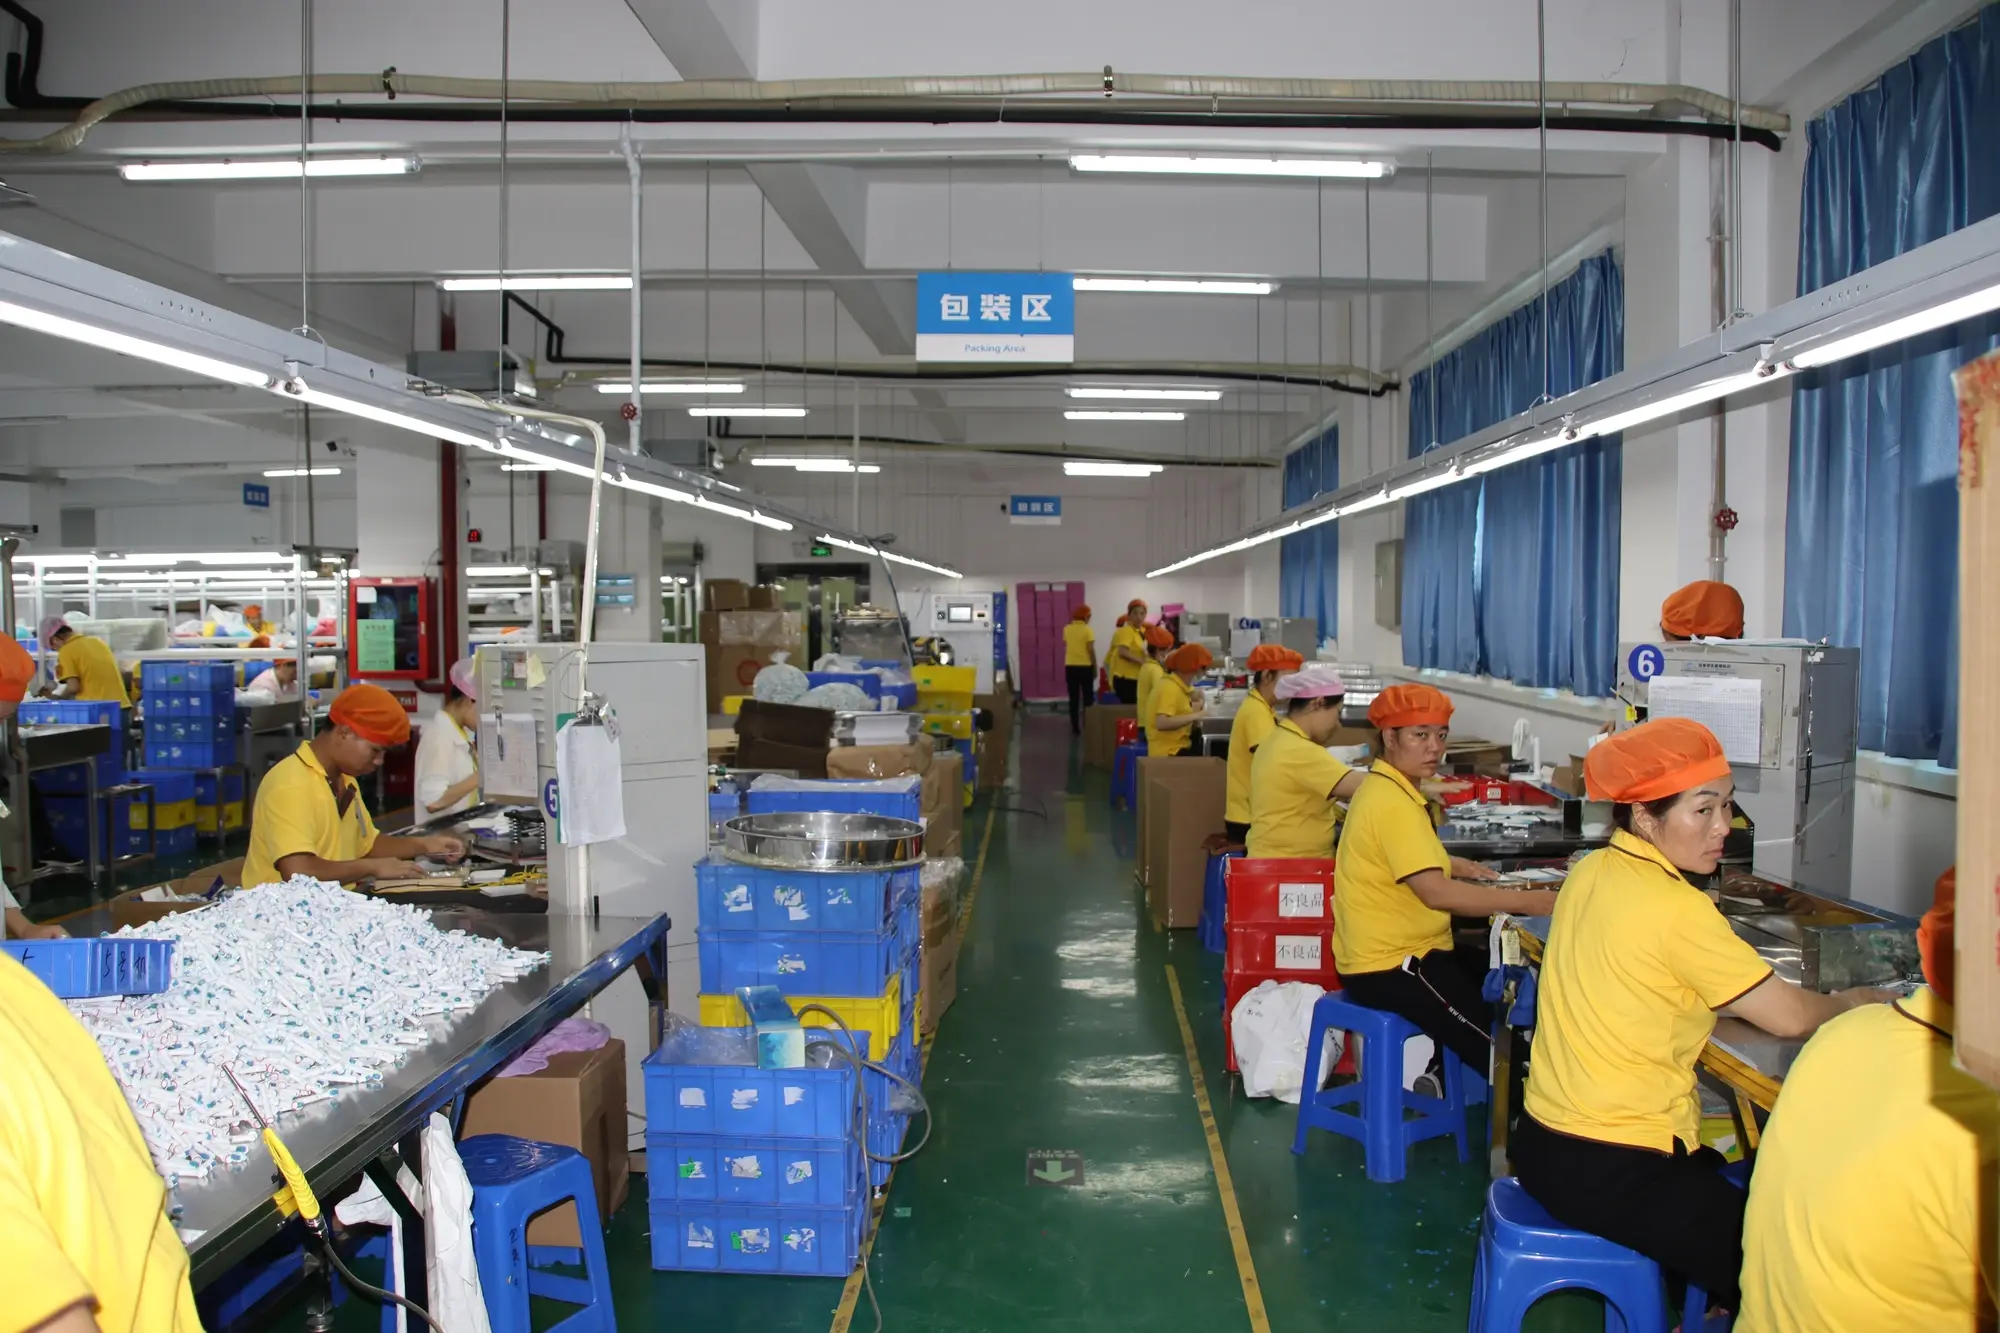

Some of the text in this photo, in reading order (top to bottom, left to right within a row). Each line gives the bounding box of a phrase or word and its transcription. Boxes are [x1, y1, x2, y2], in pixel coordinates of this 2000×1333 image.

[940, 293, 1052, 322] 包装区
[964, 344, 1026, 354] Packing Area
[1637, 650, 1655, 677] 6
[549, 784, 558, 812] 5
[1280, 892, 1324, 908] 不良品
[1276, 944, 1321, 960] 不良品
